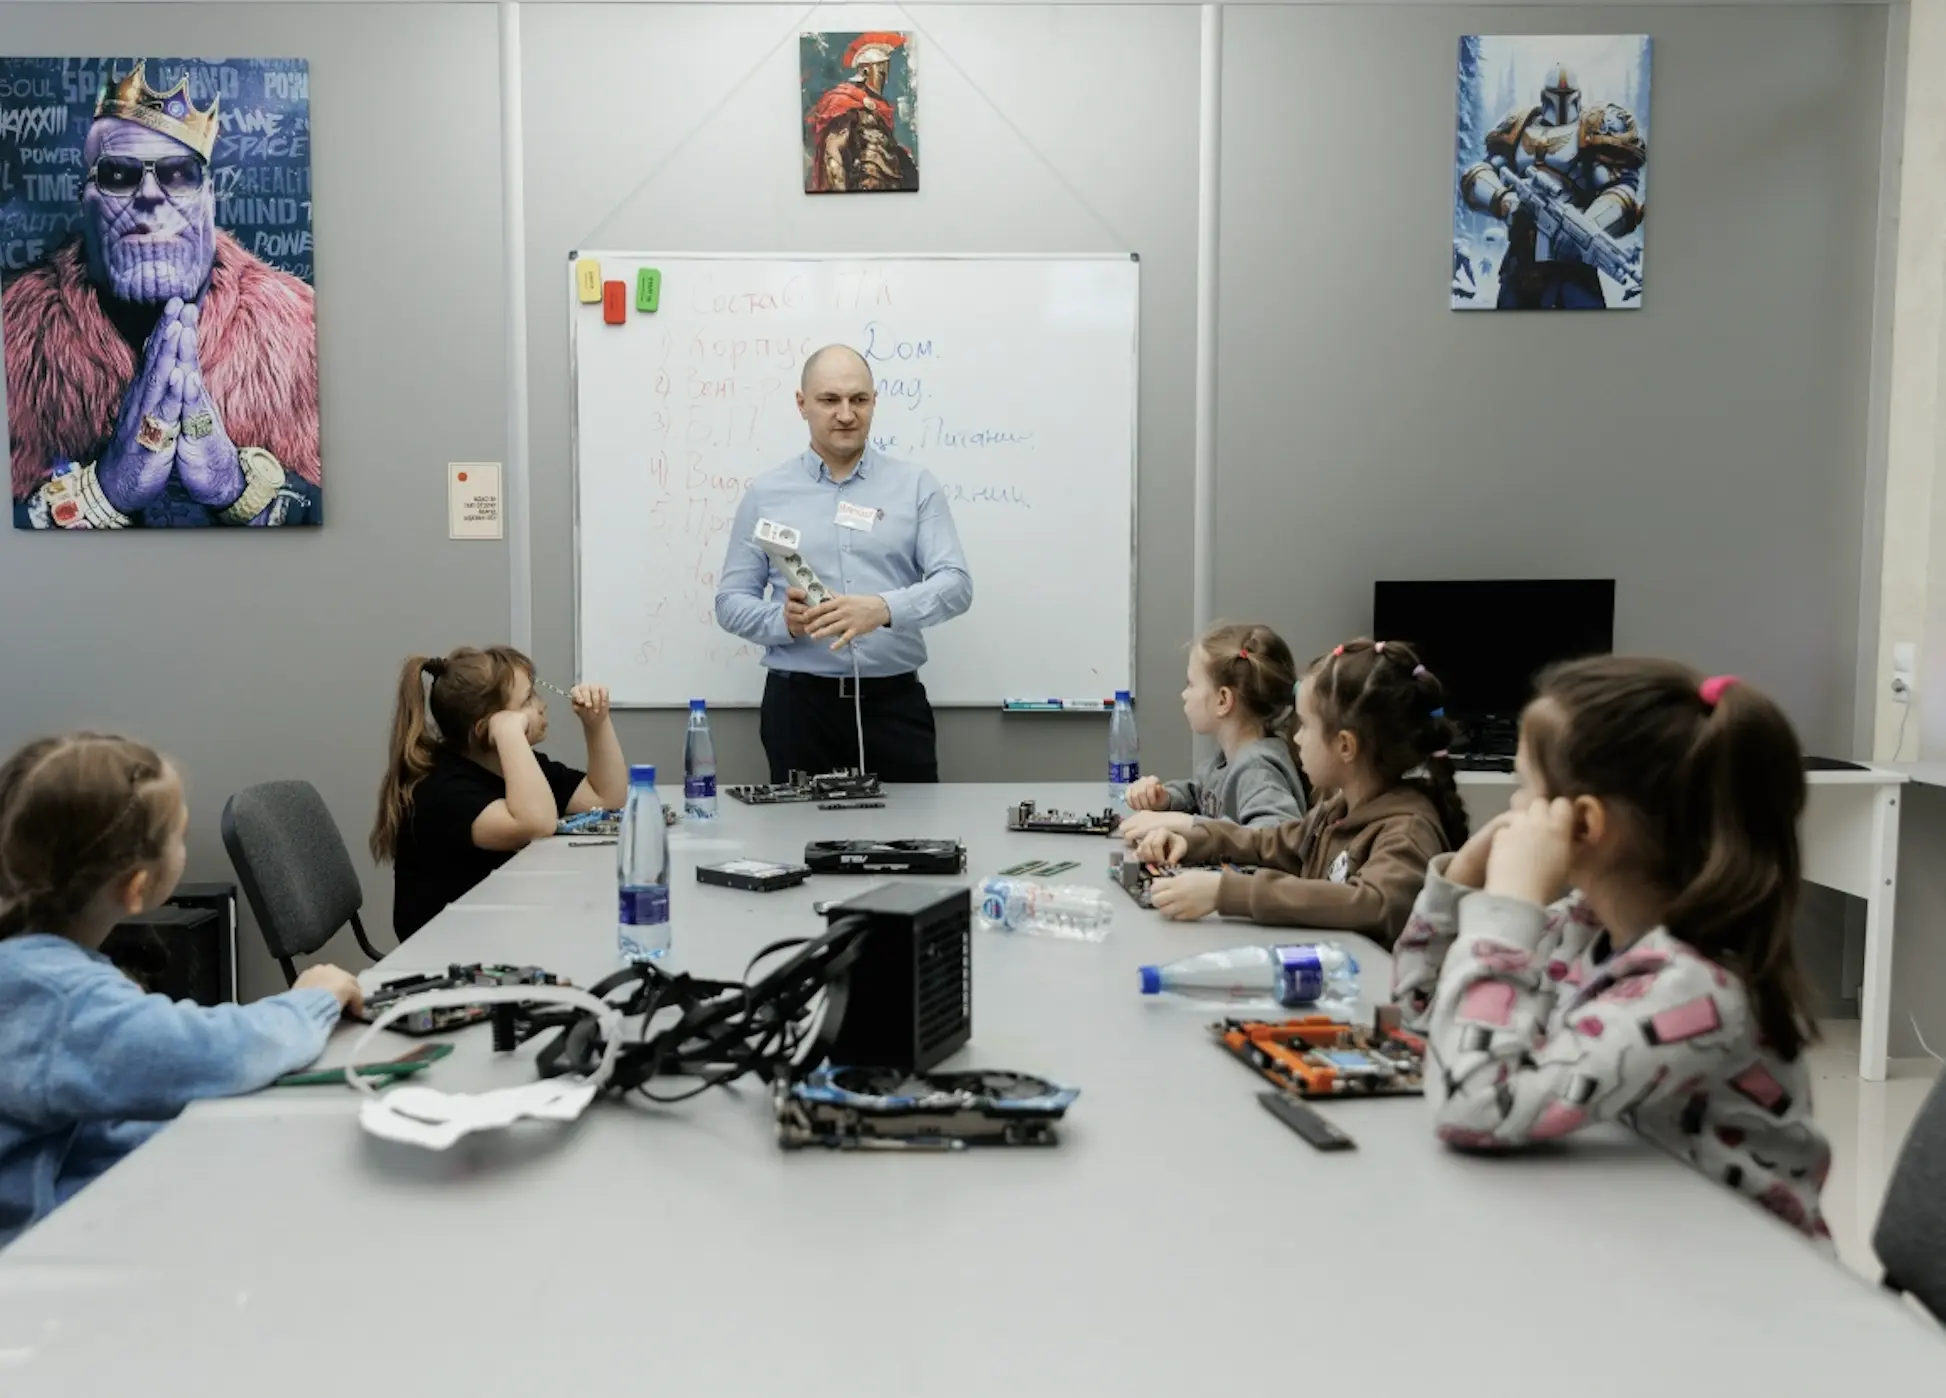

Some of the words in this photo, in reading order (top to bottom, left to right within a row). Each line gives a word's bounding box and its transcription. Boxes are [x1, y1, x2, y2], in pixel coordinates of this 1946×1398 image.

[0, 79, 56, 98] SOUL
[219, 107, 284, 136] TIME
[20, 147, 83, 167] POWER
[218, 135, 309, 160] SPACE
[22, 174, 80, 201] TIME
[219, 198, 297, 225] MIND
